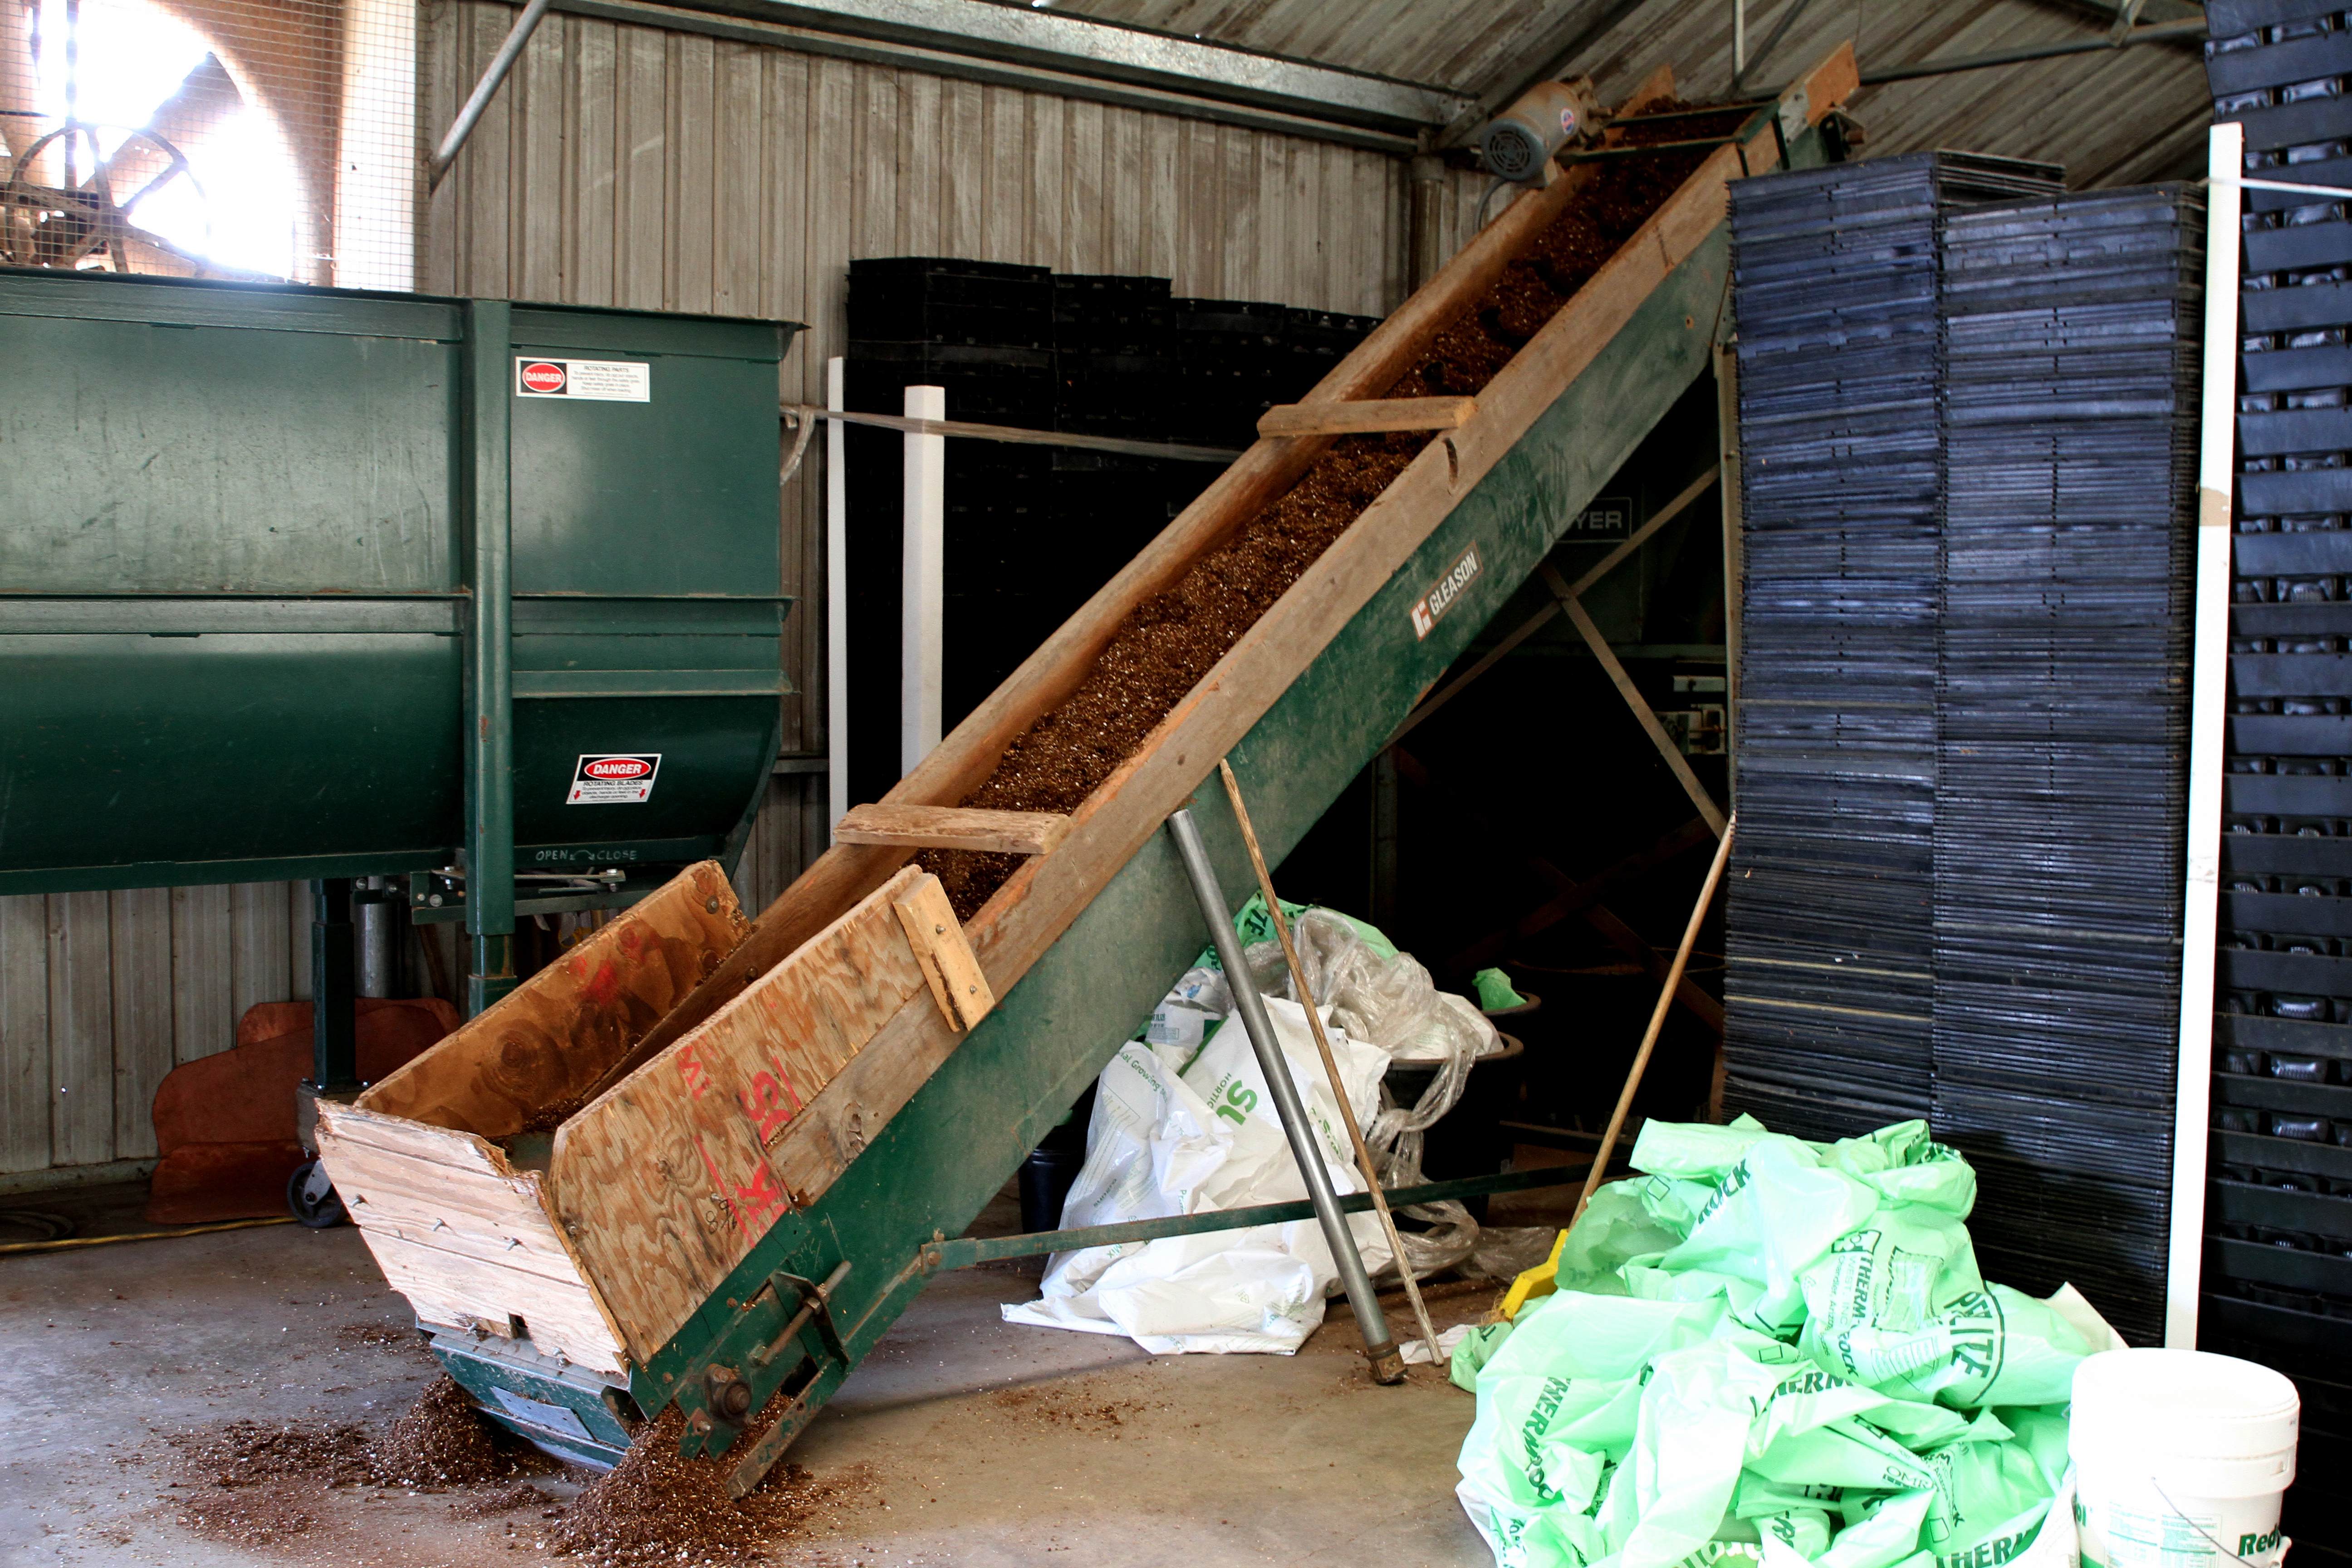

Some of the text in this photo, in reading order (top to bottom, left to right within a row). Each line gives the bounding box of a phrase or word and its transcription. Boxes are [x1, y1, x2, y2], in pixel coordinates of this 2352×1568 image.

[526, 372, 562, 383] DANGER
[1576, 509, 1622, 530] YER
[1429, 551, 1478, 616] GLEASON
[593, 764, 642, 775] DANGER
[535, 850, 637, 861] OPEN CLOSE
[1131, 1060, 1161, 1092] Growing
[1207, 1072, 1232, 1109] HORTIC
